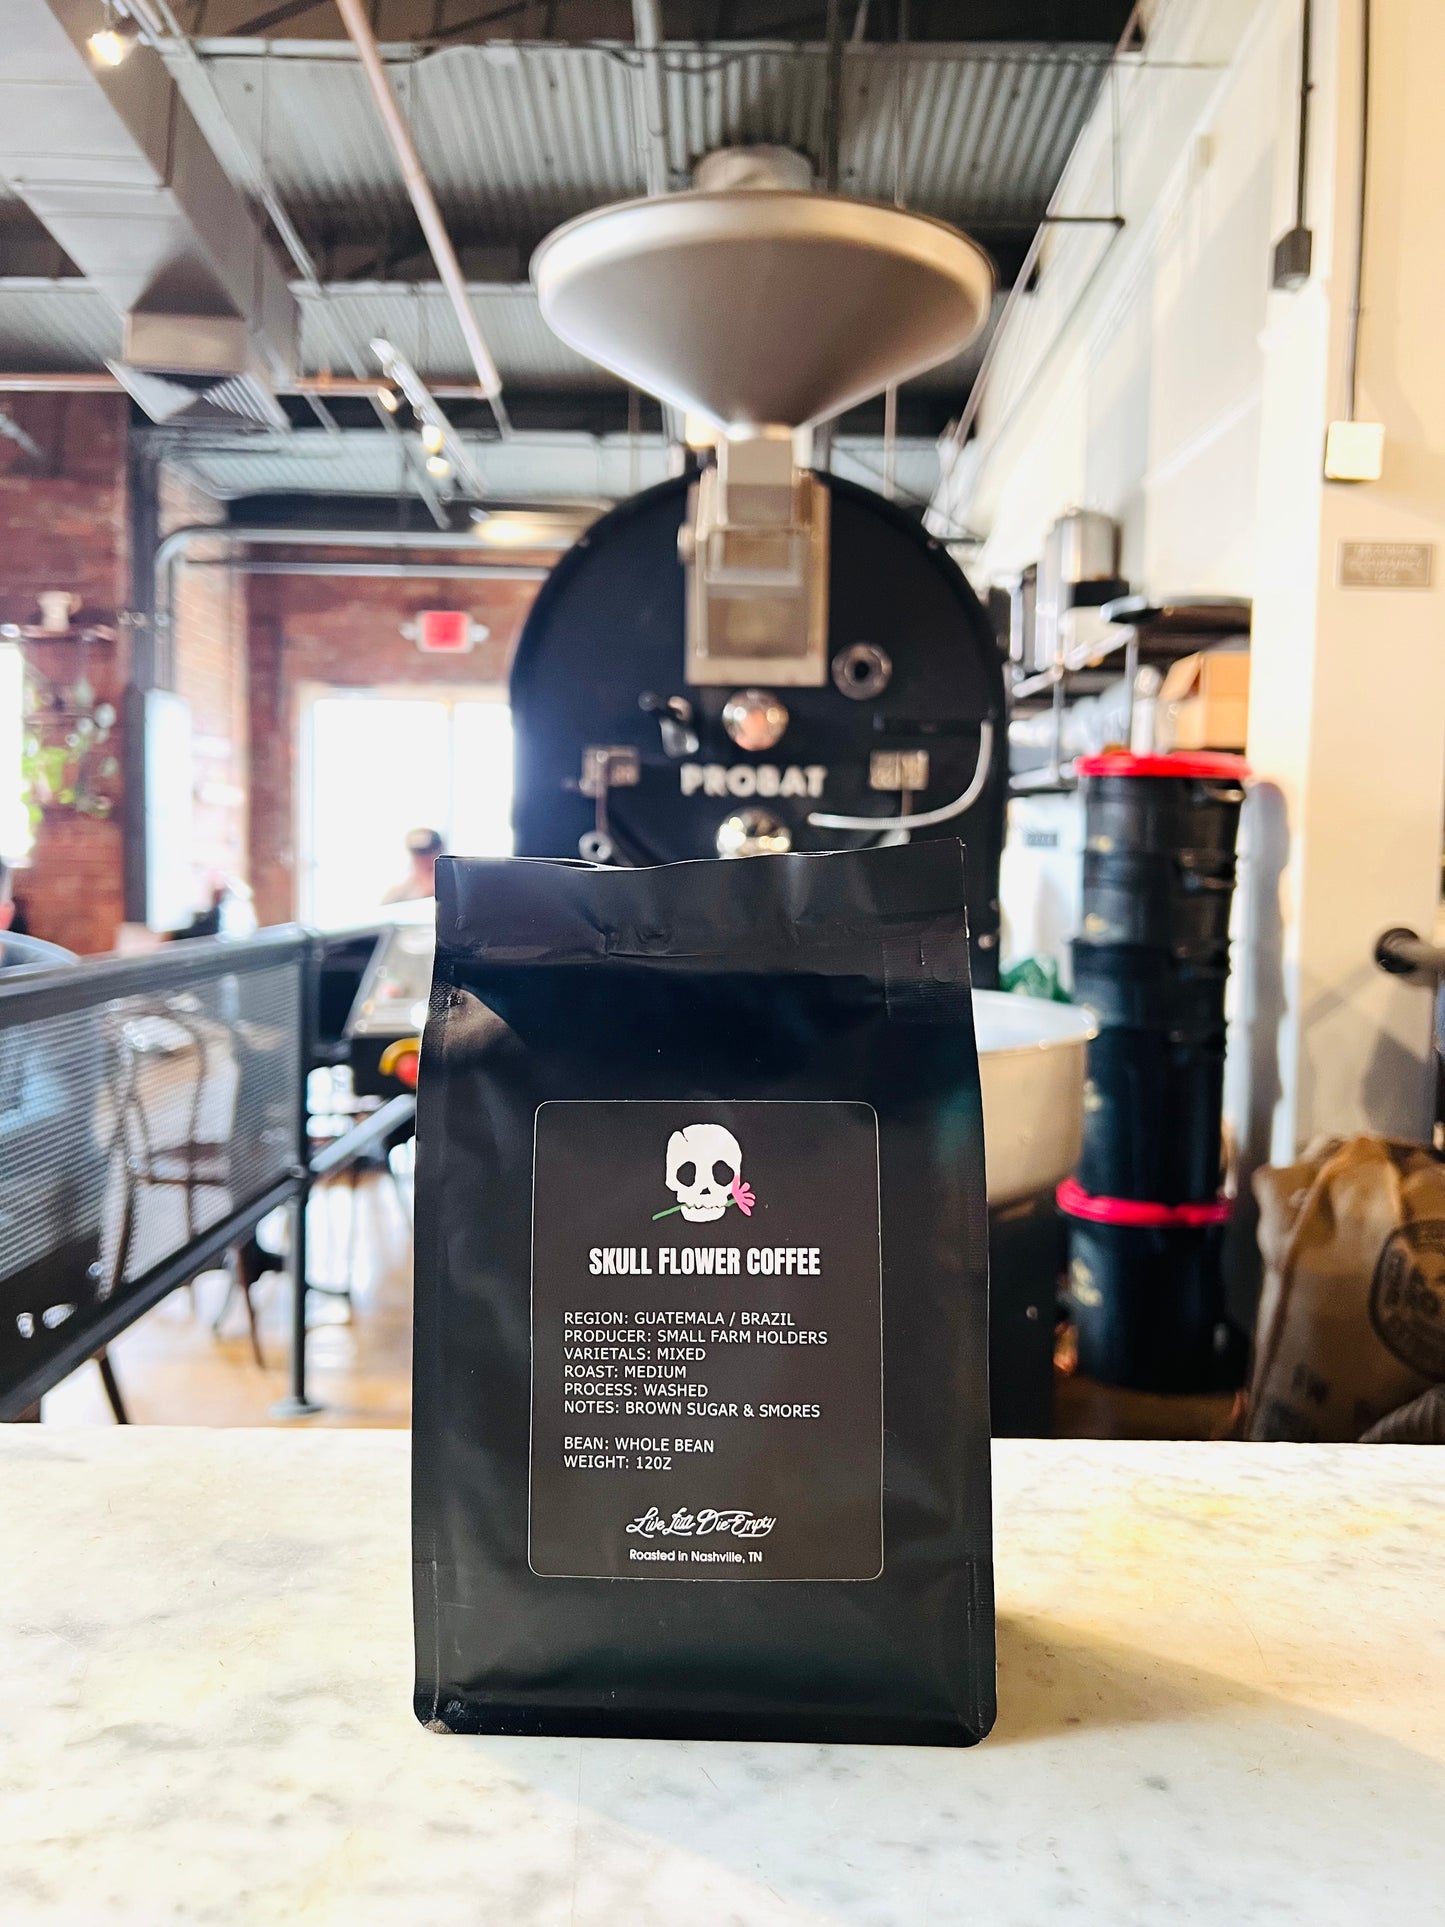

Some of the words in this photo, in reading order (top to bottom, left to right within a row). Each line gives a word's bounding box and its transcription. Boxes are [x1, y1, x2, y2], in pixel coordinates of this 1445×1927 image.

[679, 762, 828, 798] PROBAT
[588, 1247, 653, 1275] SKULL
[658, 1247, 741, 1276] FLOWER
[746, 1247, 821, 1277] COFFEE
[564, 1311, 629, 1326] REGION:
[634, 1311, 725, 1326] GUATEMALA
[741, 1311, 796, 1327] BRAZIL
[564, 1329, 652, 1343] PRODUCER:
[657, 1329, 706, 1343] SMALL
[711, 1329, 751, 1344] FARM
[756, 1330, 828, 1345] HOLDERS
[563, 1346, 651, 1361] VARIETALS:
[657, 1347, 707, 1361] MIXED
[564, 1364, 618, 1379] ROAST:
[624, 1365, 687, 1379] MEDIUM
[564, 1382, 638, 1397] PROCESS:
[643, 1383, 709, 1398] WASHED
[564, 1399, 620, 1414] NOTES:
[625, 1401, 682, 1416] BROWN
[686, 1402, 739, 1417] SUGAR
[742, 1403, 755, 1418] &
[758, 1403, 821, 1418] SMORES
[564, 1436, 609, 1451] BEAN:
[614, 1436, 670, 1452] WHOLE
[674, 1438, 714, 1453] BEAN
[563, 1454, 629, 1469] WEIGHT:
[625, 1506, 666, 1539] Live
[695, 1508, 731, 1536] Die
[726, 1513, 777, 1538] Empty
[629, 1548, 676, 1562] Roasted
[677, 1549, 689, 1562] in
[690, 1550, 746, 1564] Nashville,
[747, 1551, 763, 1563] TN
